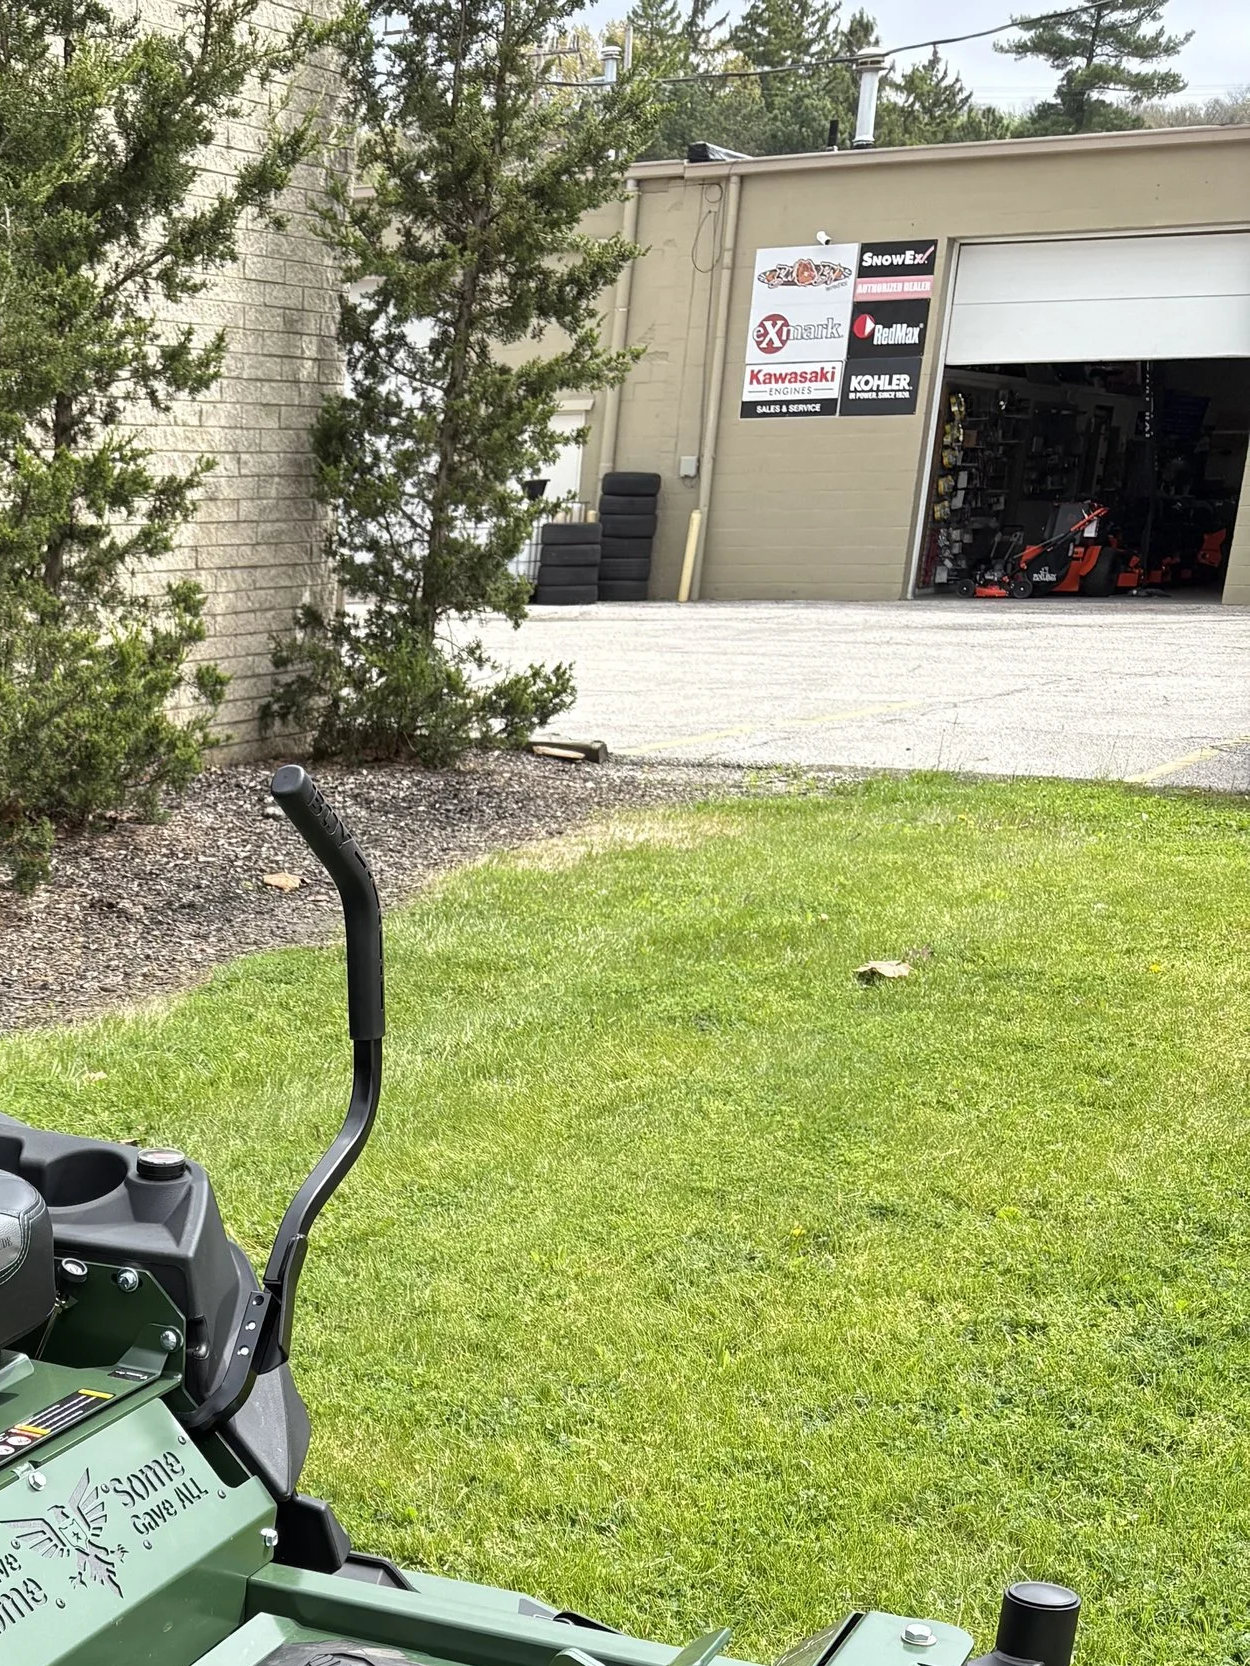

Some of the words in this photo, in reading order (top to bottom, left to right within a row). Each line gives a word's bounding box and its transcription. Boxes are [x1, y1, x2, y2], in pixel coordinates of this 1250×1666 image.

[856, 282, 902, 294] AUTHORIZED
[903, 281, 931, 292] DEALER
[873, 323, 920, 345] RedMax
[749, 366, 836, 385] Kawasaki
[769, 386, 812, 396] ENGINES
[756, 404, 781, 414] SALES
[782, 404, 787, 413] &
[789, 403, 821, 413] SERVICE
[130, 1499, 178, 1535] Gave
